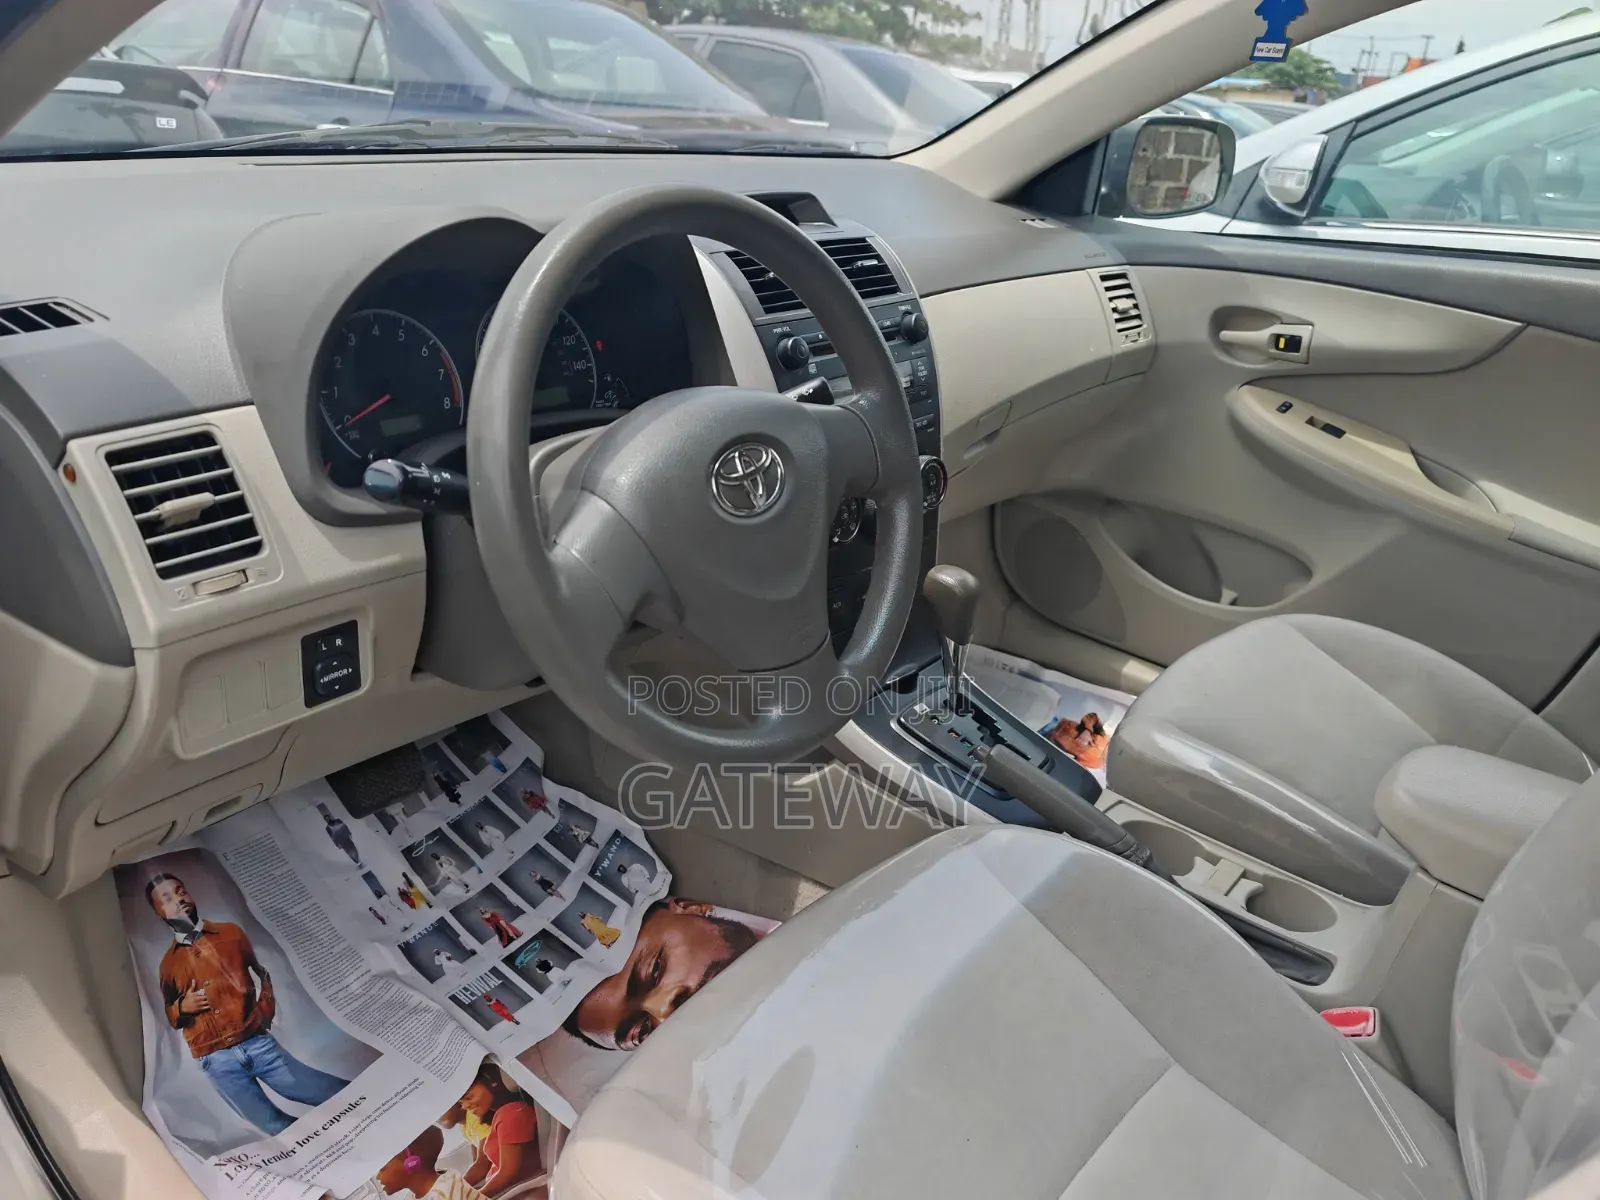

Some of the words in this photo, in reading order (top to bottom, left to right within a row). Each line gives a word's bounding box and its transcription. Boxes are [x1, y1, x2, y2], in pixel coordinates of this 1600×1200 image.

[157, 117, 176, 128] LE
[372, 325, 380, 336] 4
[398, 329, 405, 341] 5
[348, 334, 356, 345] 3
[562, 334, 576, 346] 120
[421, 345, 429, 357] 6
[334, 356, 342, 368] 2
[572, 359, 587, 371] 140
[438, 369, 445, 381] 7
[333, 386, 338, 398] 1
[443, 397, 451, 409] 8
[322, 643, 327, 651] L
[335, 638, 342, 647] R
[323, 668, 348, 682] MIRROR
[594, 836, 622, 877] Y'WAND
[452, 970, 504, 1006] REVIVAL
[261, 1147, 297, 1167] tender
[295, 1130, 321, 1148] love
[321, 1094, 367, 1131] capsules
